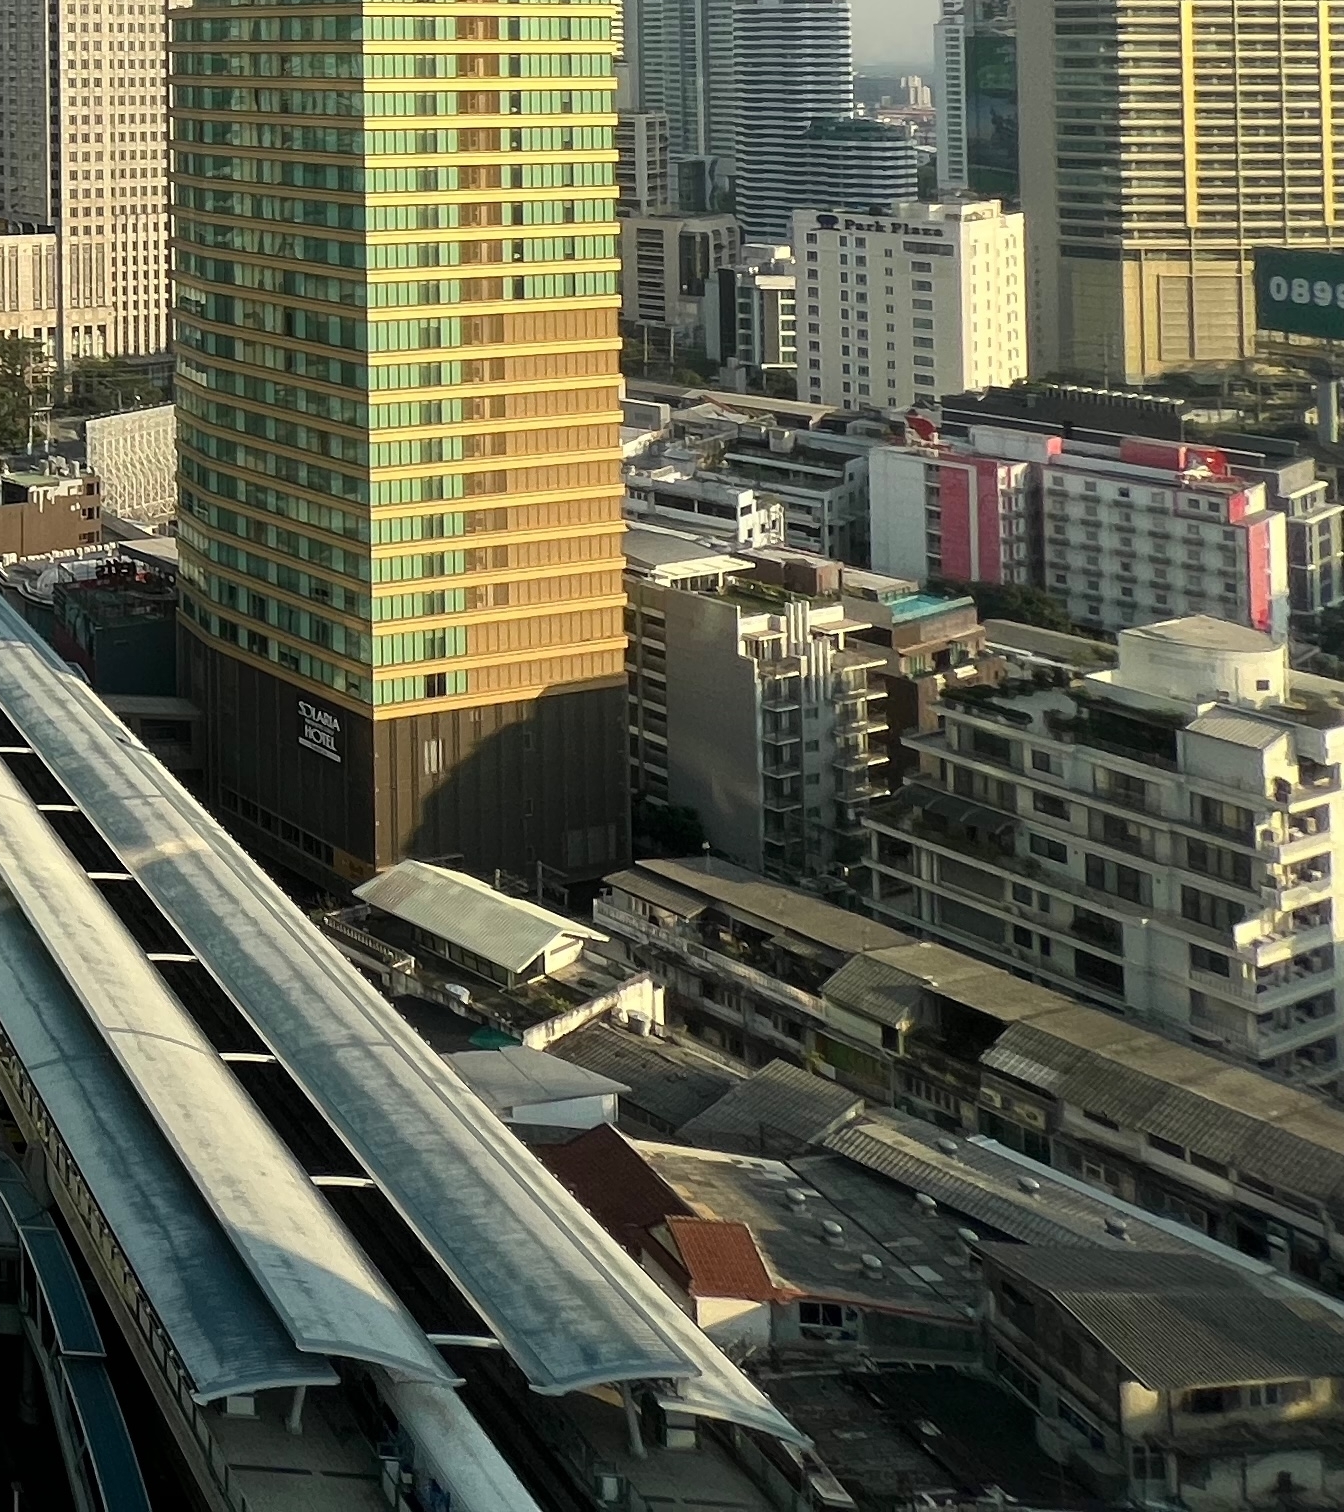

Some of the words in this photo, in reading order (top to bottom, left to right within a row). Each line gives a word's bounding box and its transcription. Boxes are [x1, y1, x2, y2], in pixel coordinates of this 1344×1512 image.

[844, 218, 886, 233] Park
[890, 222, 944, 237] Plaza
[297, 700, 341, 732] SOLARIA
[304, 724, 338, 752] HOTEL
